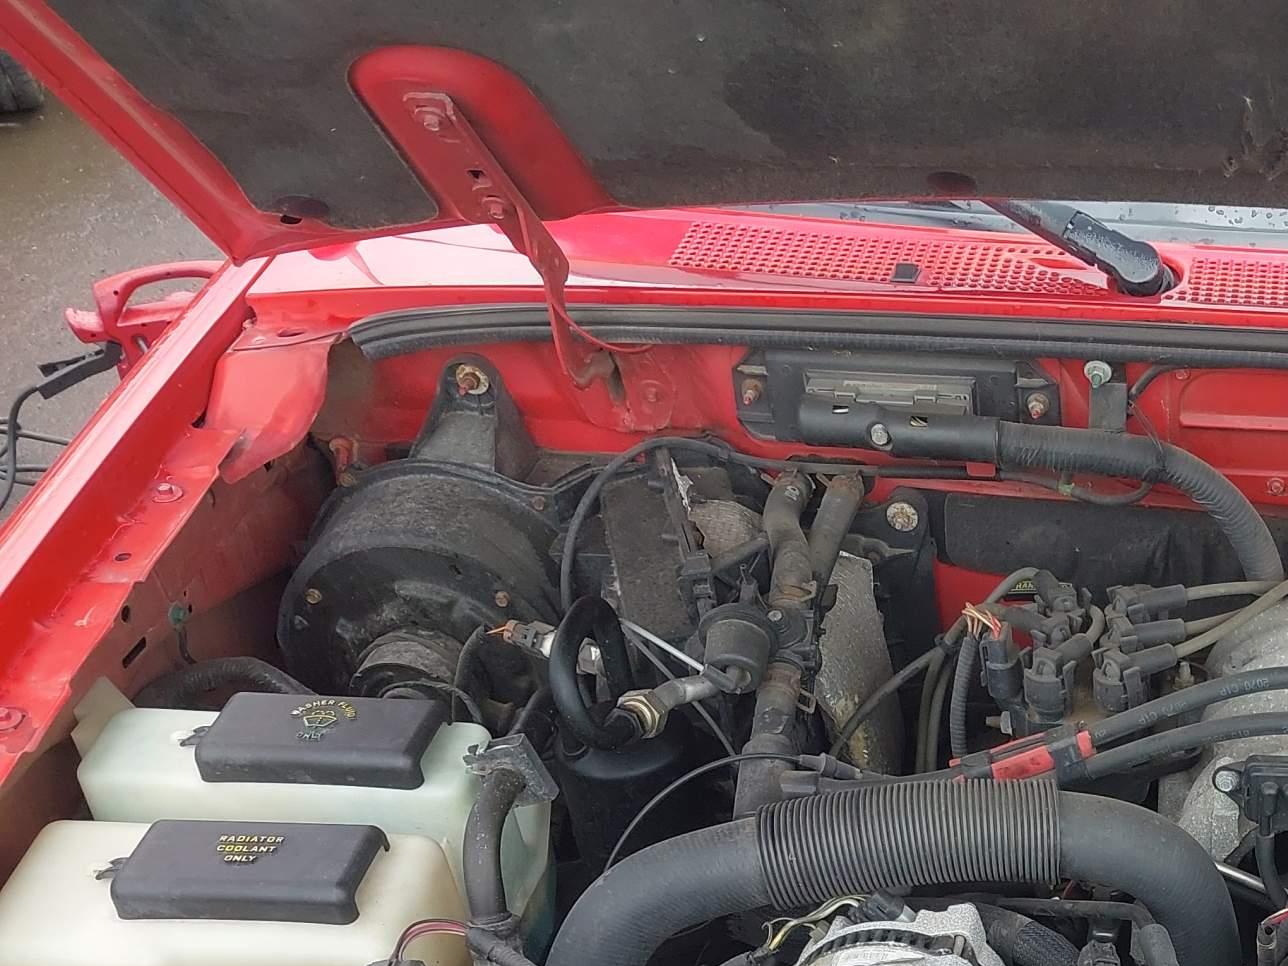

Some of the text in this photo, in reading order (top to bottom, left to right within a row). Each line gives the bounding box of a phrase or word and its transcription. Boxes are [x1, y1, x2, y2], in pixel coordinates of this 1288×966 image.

[219, 835, 285, 843] RADIATOR
[216, 844, 277, 852] COOLANT
[223, 854, 257, 862] ONLY
